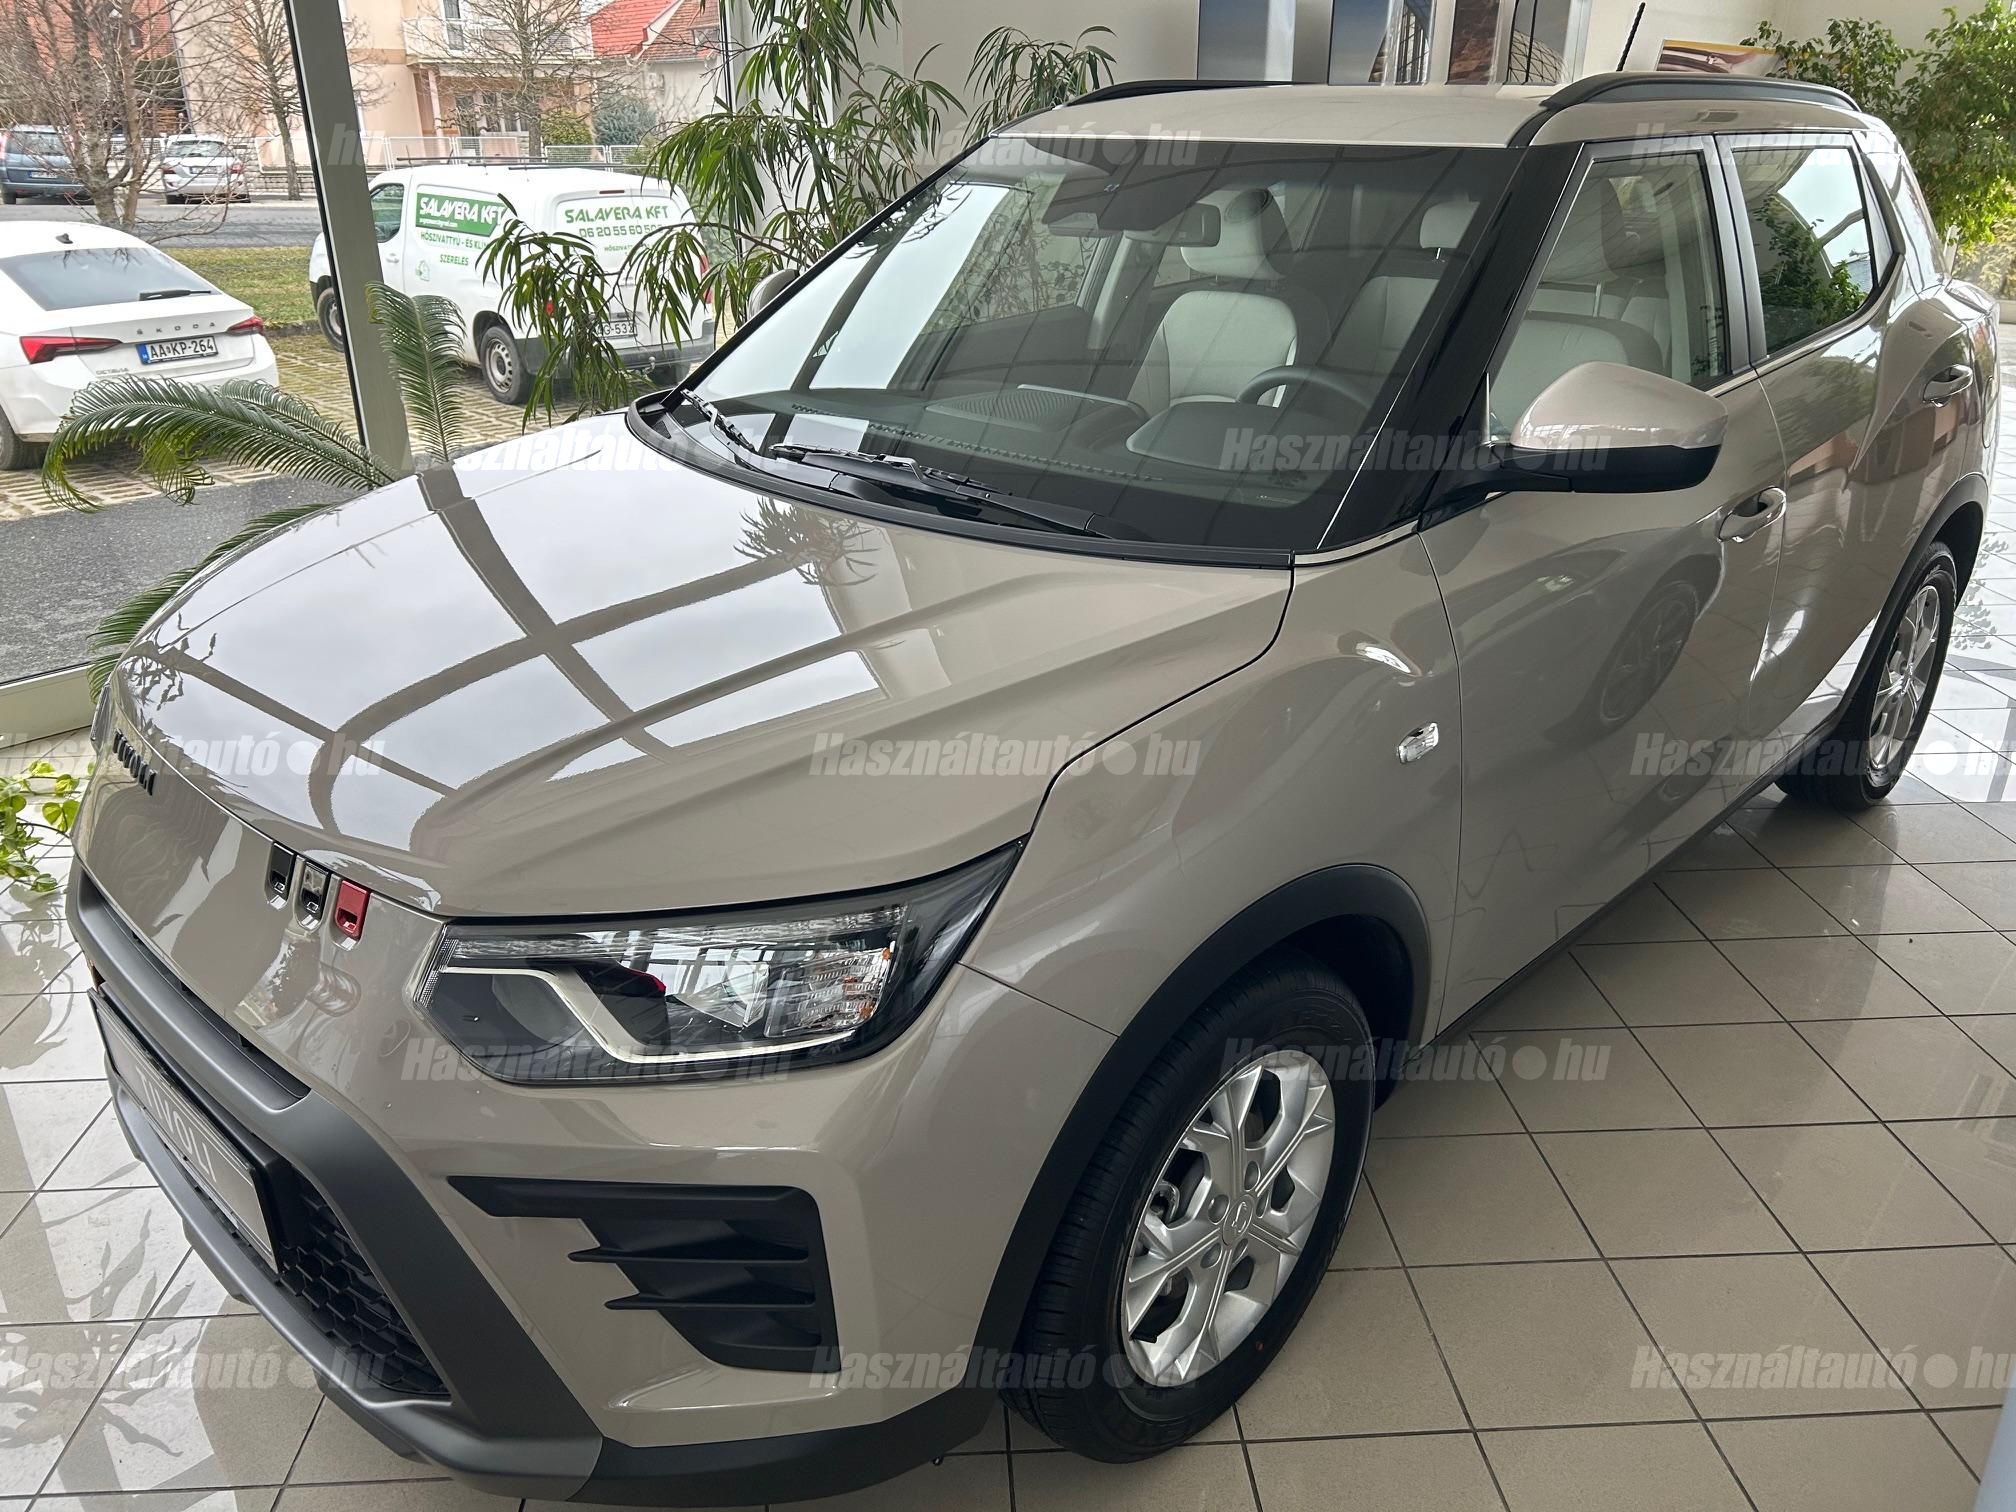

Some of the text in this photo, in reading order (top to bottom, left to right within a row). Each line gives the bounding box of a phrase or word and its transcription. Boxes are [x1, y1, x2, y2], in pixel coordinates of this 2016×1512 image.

[420, 197, 479, 222] SALAVERA
[480, 205, 506, 225] KFT
[564, 205, 668, 224] SALAVERA KFT
[579, 227, 595, 238] 06
[596, 226, 611, 237] 20
[613, 225, 627, 236] 55
[629, 224, 643, 235] 60
[135, 1065, 217, 1183] TIVOLI
